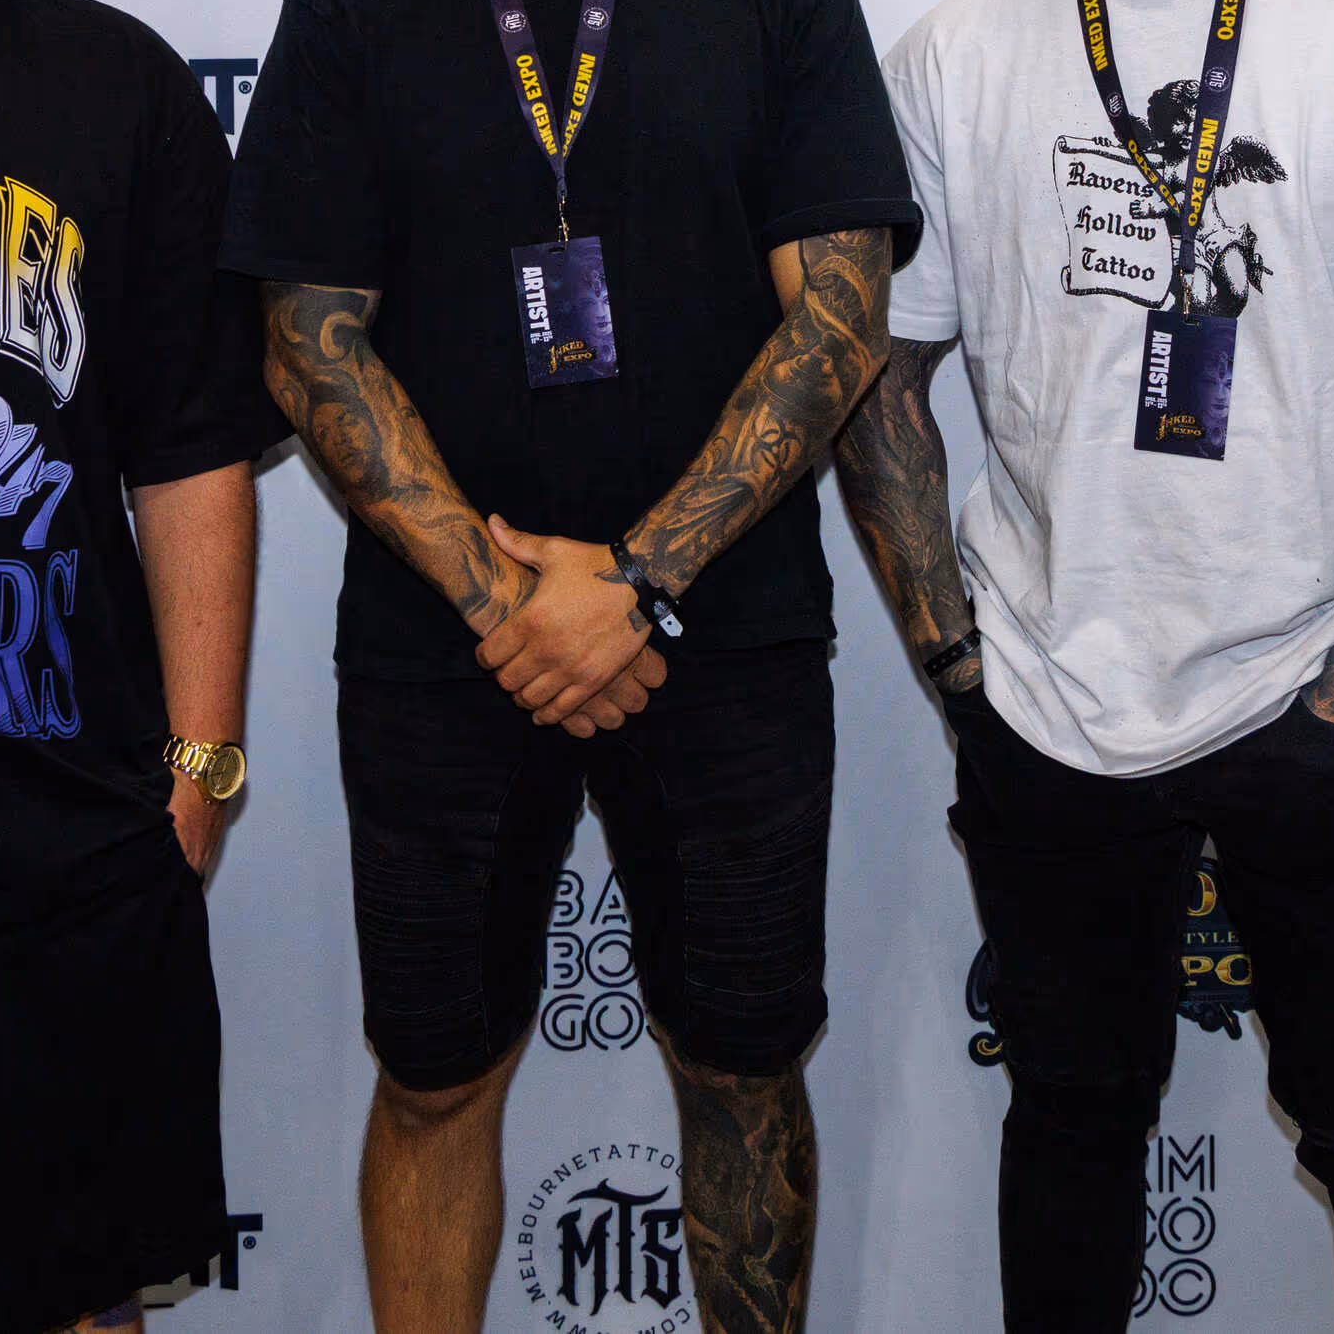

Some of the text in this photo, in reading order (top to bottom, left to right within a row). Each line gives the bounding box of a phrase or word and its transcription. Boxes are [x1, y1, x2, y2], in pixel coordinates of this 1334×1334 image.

[1088, 22, 1109, 72] INKED
[516, 54, 558, 156] INKED EXPO
[571, 53, 596, 107] INKED
[1067, 161, 1155, 198] Ravens
[1127, 139, 1158, 185] EXPO
[1188, 117, 1220, 227] INKED EXPO
[1074, 204, 1157, 242] Hollow
[1081, 247, 1156, 282] Tattoo
[522, 266, 552, 330] ARTIST
[1147, 330, 1173, 398] ARTIST
[553, 867, 627, 927] BA
[543, 929, 638, 989] BO
[541, 991, 646, 1052] GO
[556, 1178, 684, 1316] MTS
